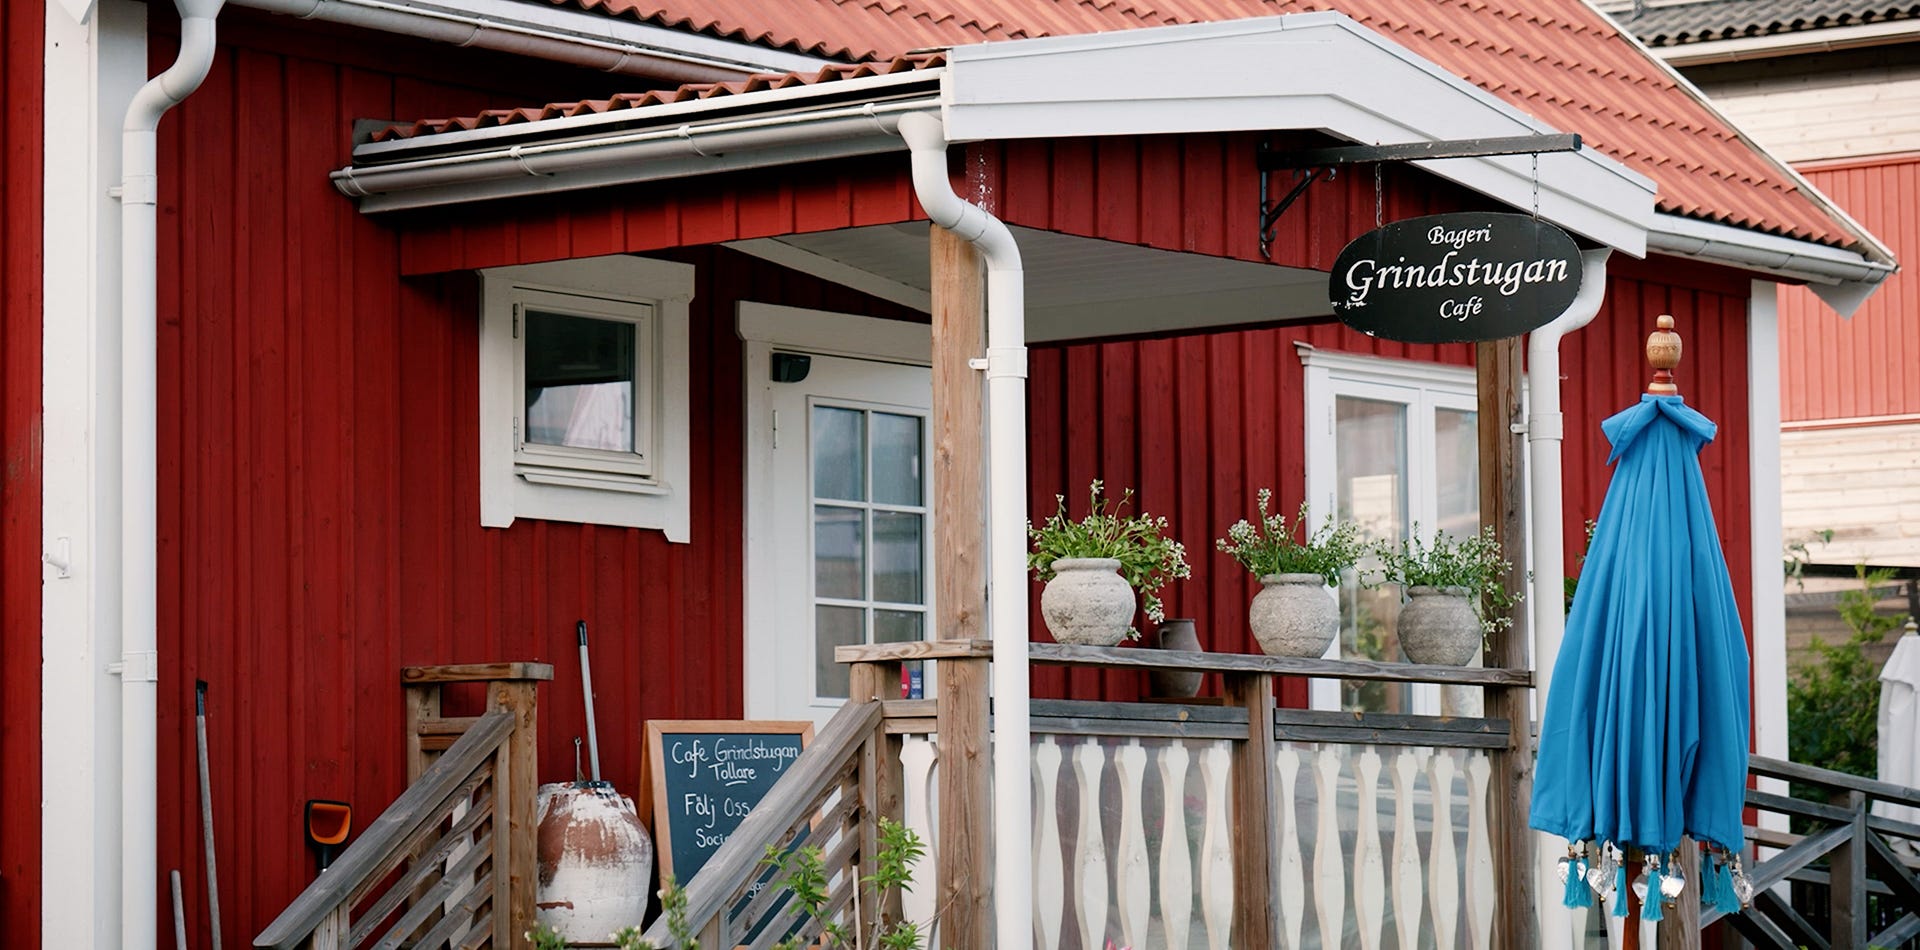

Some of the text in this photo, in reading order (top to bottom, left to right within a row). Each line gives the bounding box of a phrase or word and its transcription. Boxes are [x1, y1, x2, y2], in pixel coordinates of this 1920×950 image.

[1427, 224, 1492, 249] Bageri
[1345, 251, 1568, 302] Grindstugan
[1439, 296, 1483, 321] Café
[714, 738, 798, 772] Grindstugan
[708, 761, 757, 781] Tollare
[684, 793, 751, 829] Följ Oss
